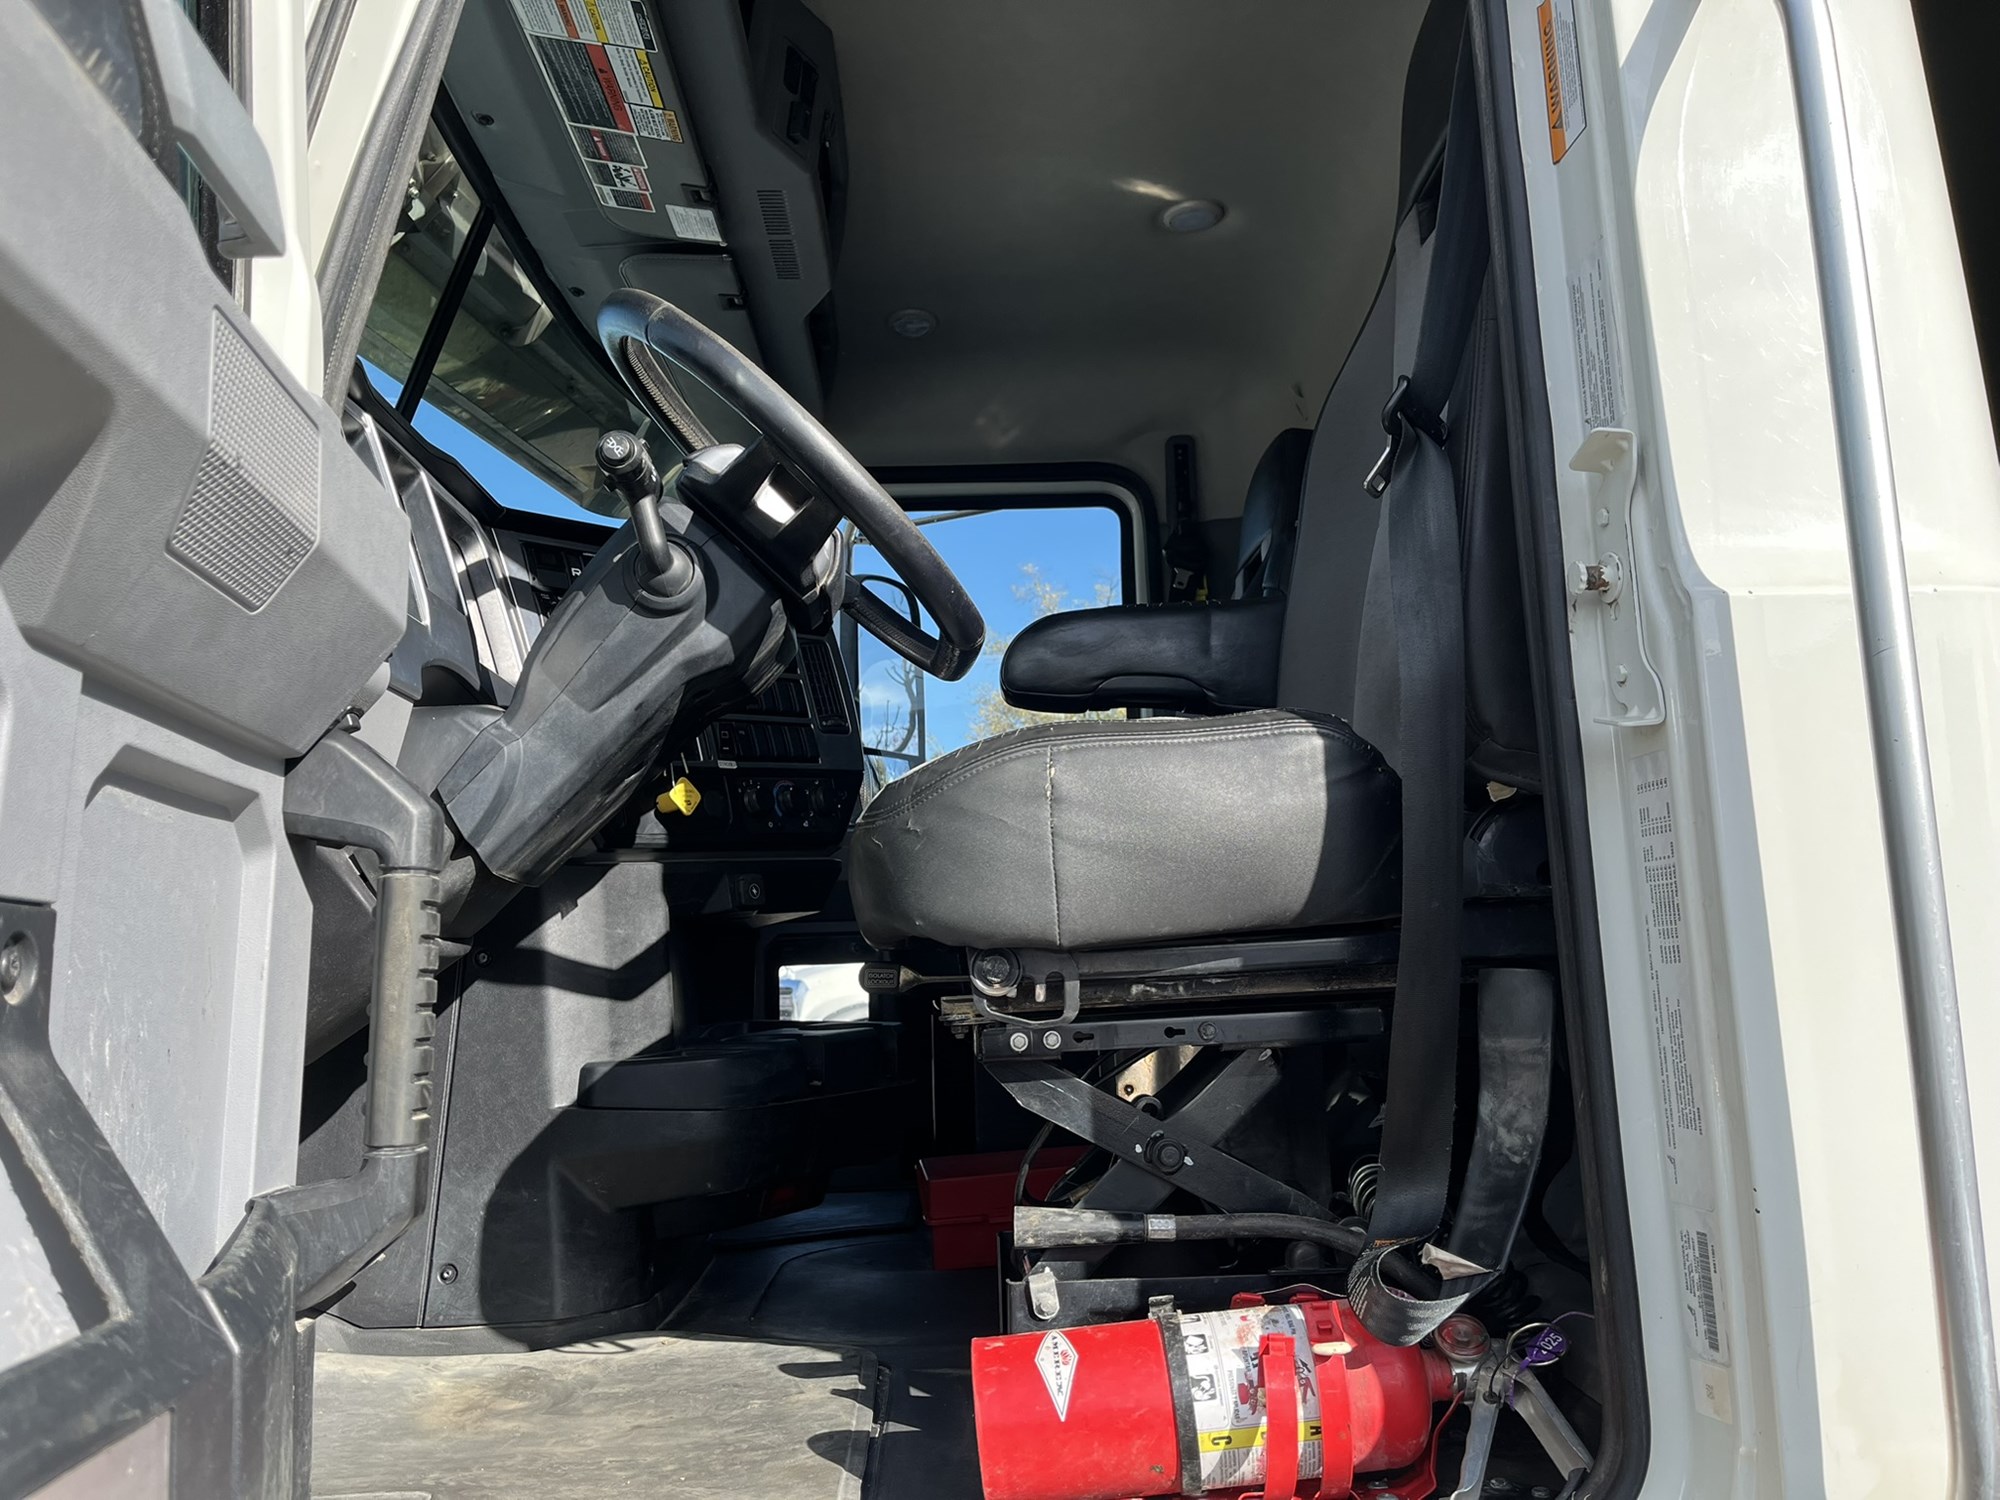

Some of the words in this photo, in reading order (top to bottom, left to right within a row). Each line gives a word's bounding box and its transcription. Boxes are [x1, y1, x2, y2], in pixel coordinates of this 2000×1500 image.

[643, 66, 656, 93] CAUTION
[1544, 19, 1560, 113] WARNING
[602, 76, 622, 111] WARNING
[1052, 1335, 1064, 1397] AMEREX
[1211, 1435, 1233, 1447] C
[1309, 1425, 1322, 1436] A
